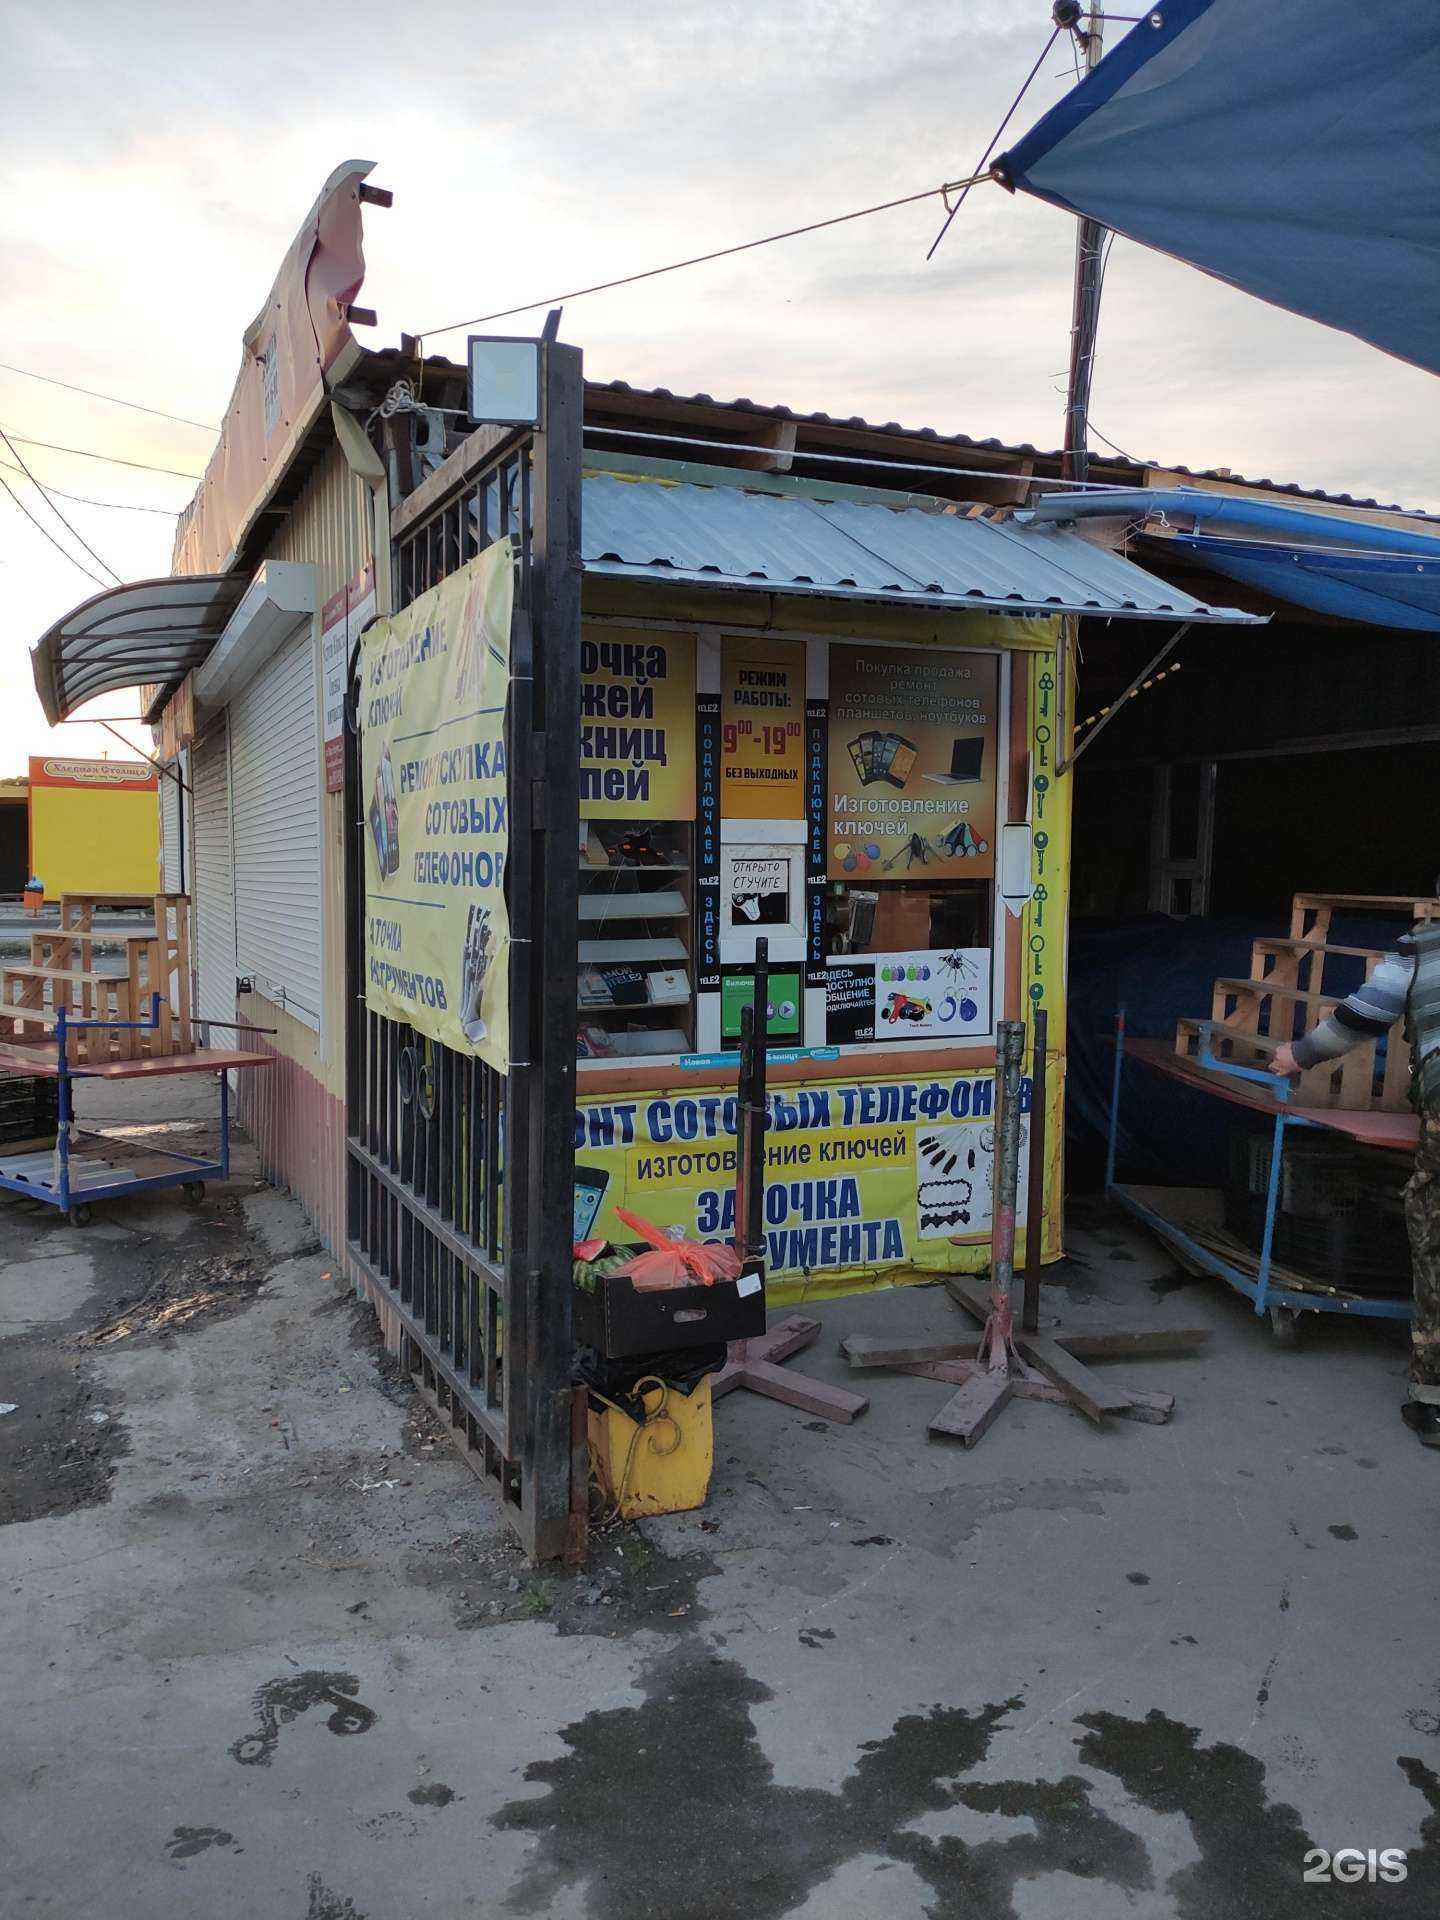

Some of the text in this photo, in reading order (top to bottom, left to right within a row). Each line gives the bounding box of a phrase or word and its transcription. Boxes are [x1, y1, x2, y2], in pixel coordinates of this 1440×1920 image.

[580, 641, 667, 679] очка
[855, 660, 911, 677] Покупка
[738, 670, 787, 687] РЕЖИМ
[890, 680, 936, 691] ремонт
[734, 690, 792, 708] РАБОТЫ:
[845, 693, 981, 709] сотовых телефонов
[920, 712, 987, 725] ноутбуков
[579, 760, 650, 801] пей
[725, 767, 799, 780] БЕЗ ВЫХОДНЫХ
[833, 794, 970, 814] Изготовление
[425, 797, 506, 836] СОТОВЫХ
[833, 818, 909, 836] ключей
[733, 862, 780, 873] ОТКРЫТО
[699, 876, 719, 886] TELE2
[733, 877, 781, 889] СТУЧИТЕ
[807, 875, 827, 884] TELE2
[703, 896, 714, 964] ЗДЕСЬ
[811, 895, 822, 960] ЗДЕСЬ
[699, 976, 720, 986] TELE2
[647, 1090, 831, 1143] СОТОЫХ
[836, 1077, 1033, 1126] ТЕЛЕФОНВ
[637, 1129, 906, 1180] изготовние ключей
[697, 1178, 860, 1233] ЗАОЧКА
